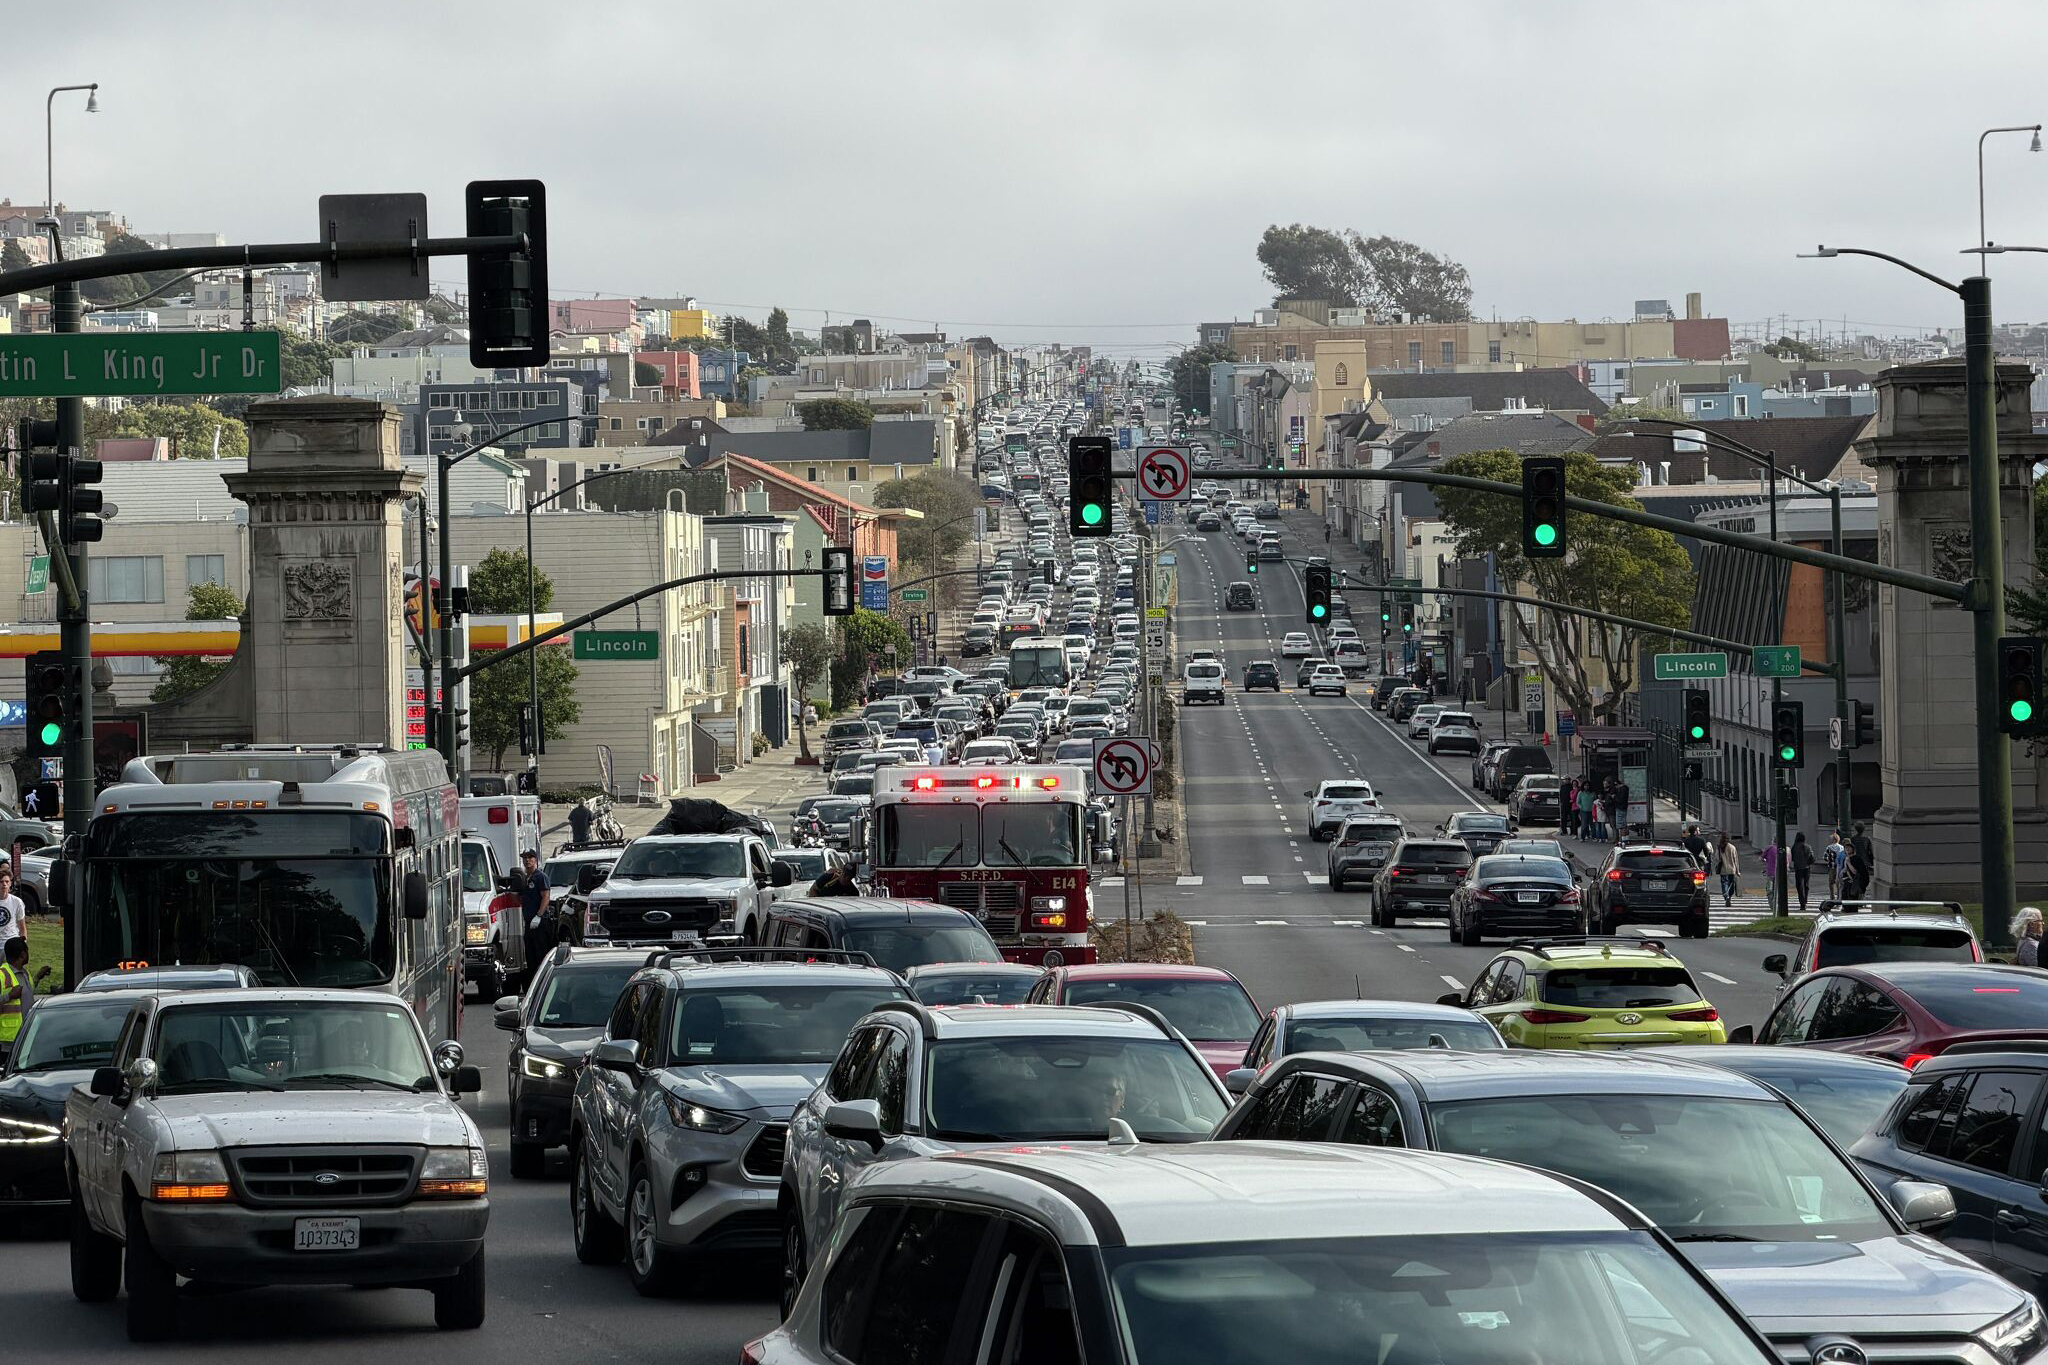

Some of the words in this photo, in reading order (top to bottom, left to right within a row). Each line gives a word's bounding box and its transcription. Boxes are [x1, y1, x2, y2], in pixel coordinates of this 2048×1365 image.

[64, 350, 76, 379] L
[104, 349, 164, 388] King
[193, 348, 221, 379] Jr
[242, 347, 265, 377] Dr
[586, 639, 647, 651] Lincoln
[1665, 661, 1717, 672] Lincoln
[1780, 664, 1795, 672] ZOO
[1526, 693, 1541, 702] 20
[960, 870, 1005, 881] S.F.F.D.
[1052, 876, 1076, 889] E14
